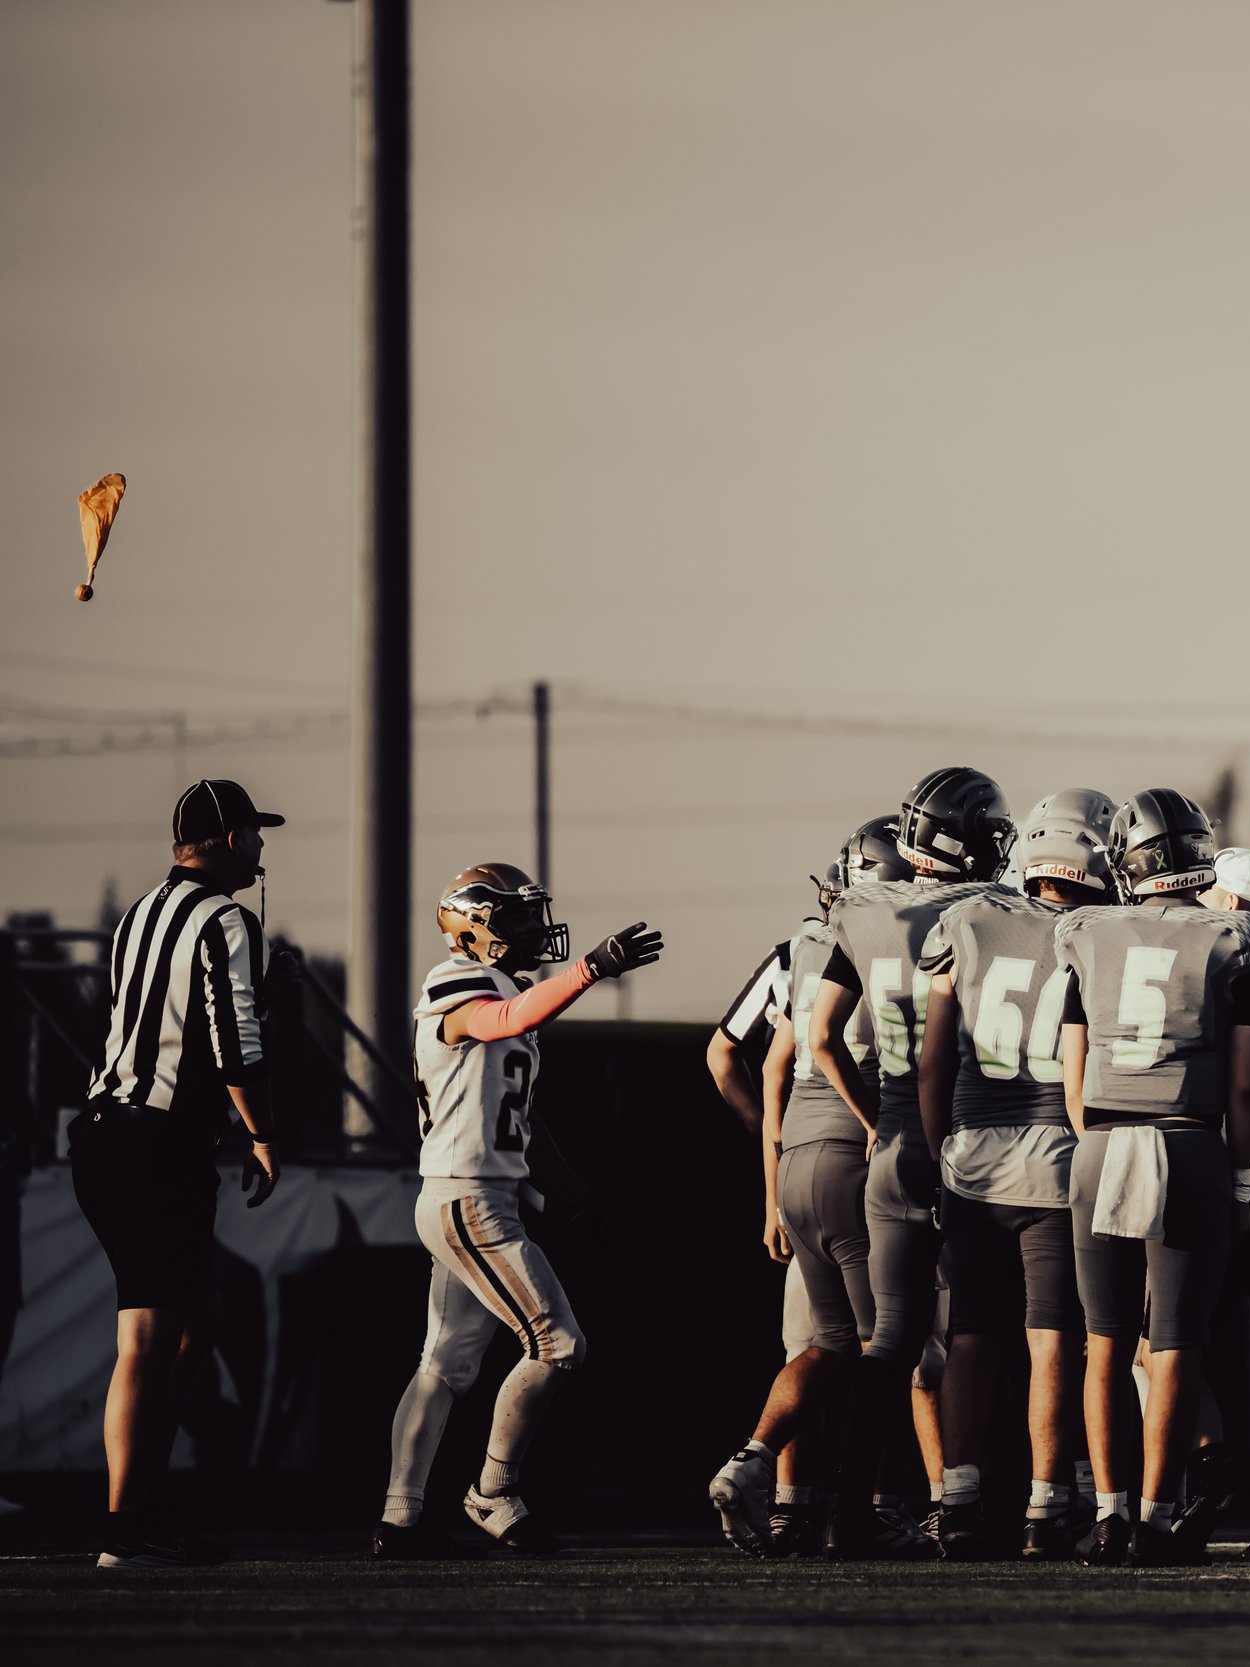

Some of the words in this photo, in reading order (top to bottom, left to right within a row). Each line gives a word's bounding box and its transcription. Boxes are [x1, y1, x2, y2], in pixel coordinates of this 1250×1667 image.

[1035, 863, 1087, 882] Riddell
[1154, 873, 1205, 890] Riddell
[1111, 946, 1178, 1070] 5
[494, 1049, 533, 1152] 2
